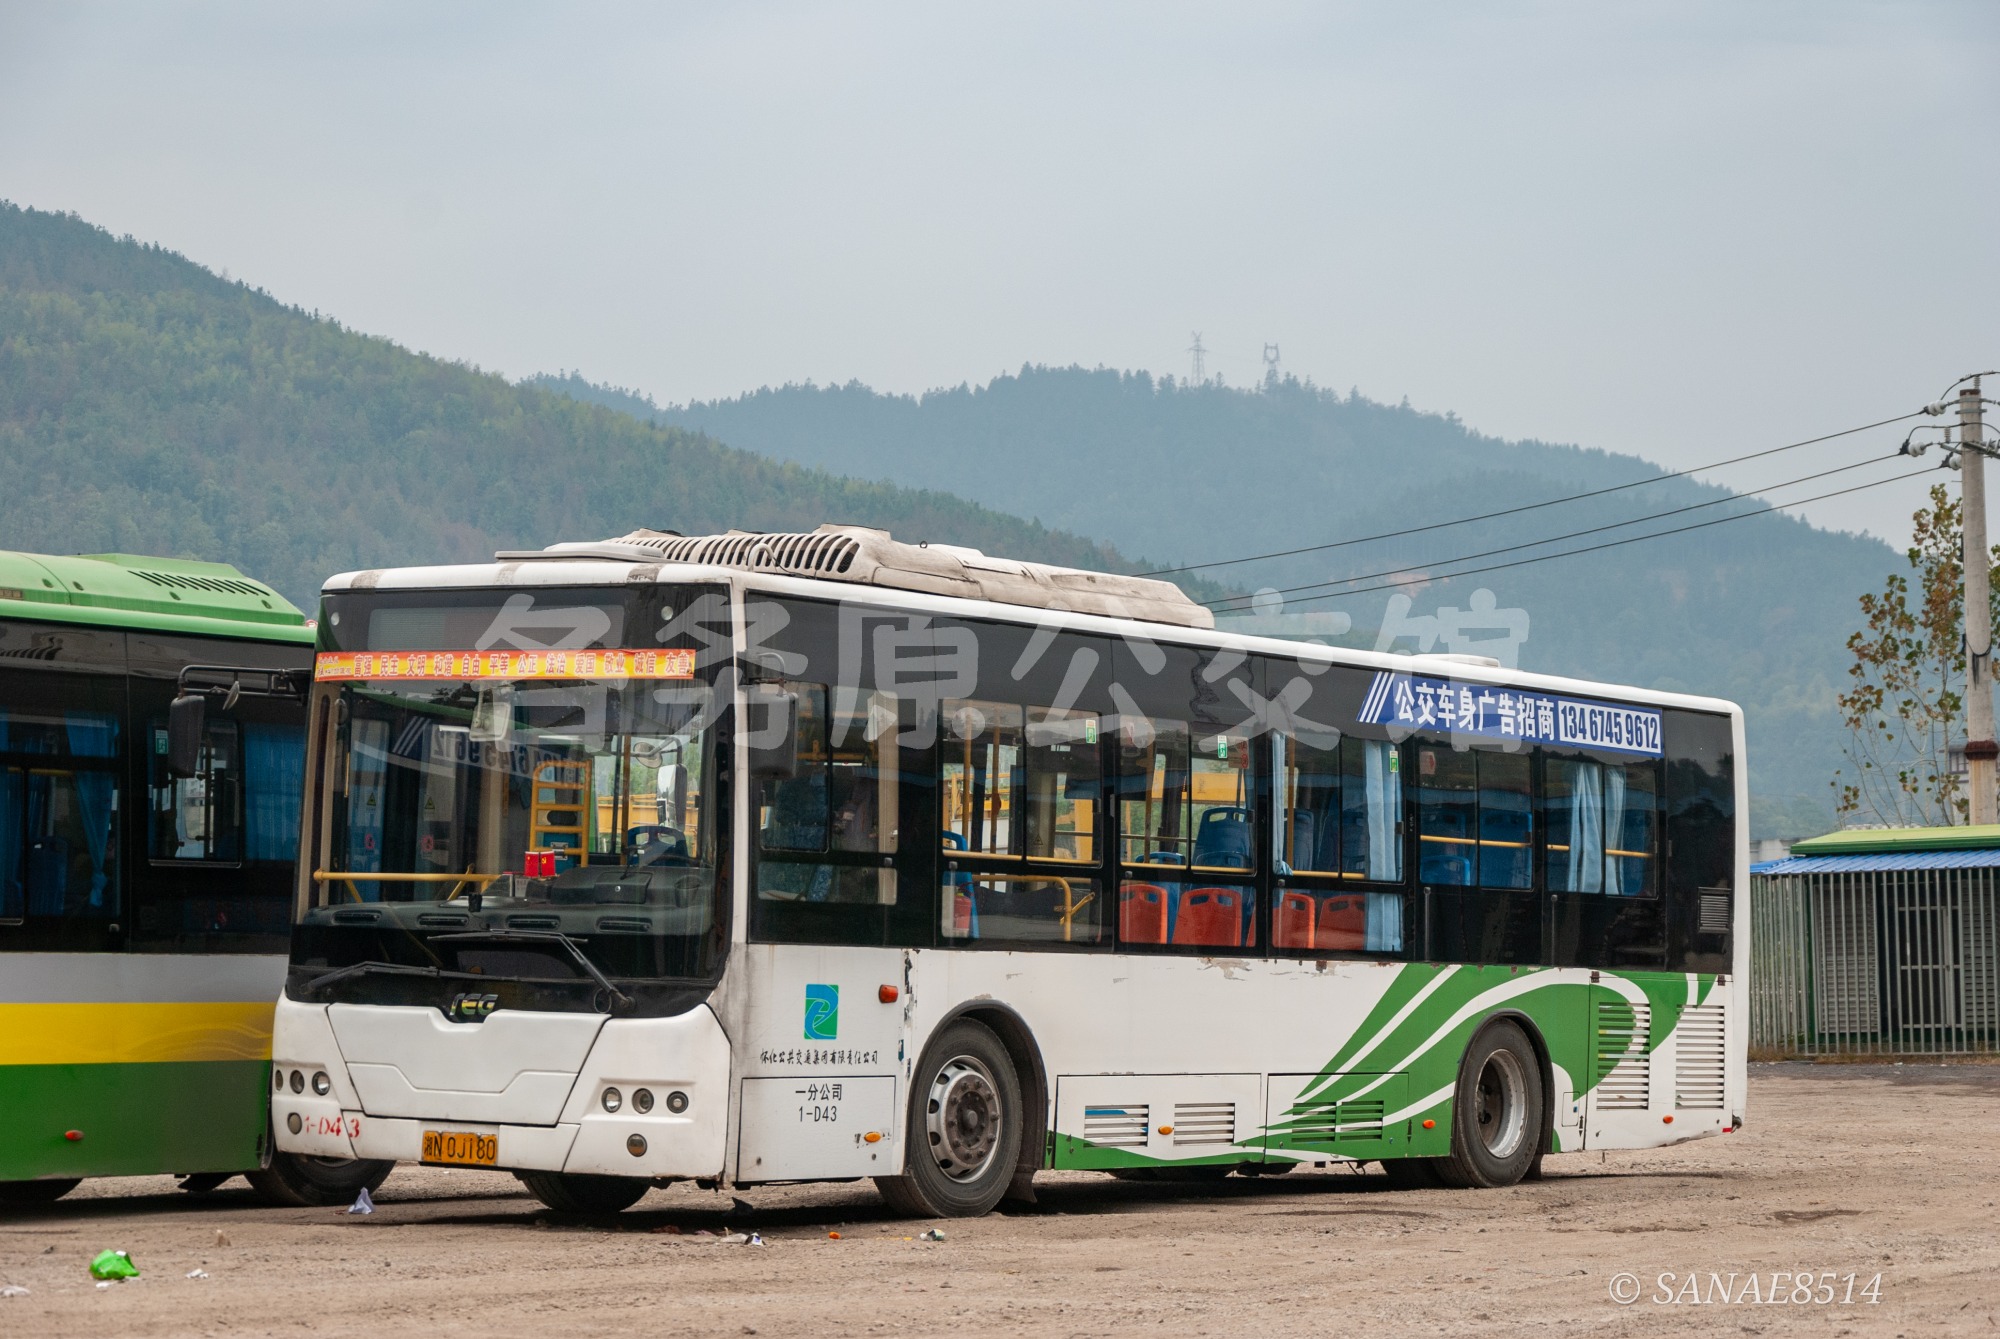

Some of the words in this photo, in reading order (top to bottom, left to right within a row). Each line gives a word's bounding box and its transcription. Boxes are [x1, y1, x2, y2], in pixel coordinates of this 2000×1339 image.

[354, 654, 372, 677] 富强
[380, 654, 399, 677] 民主
[406, 654, 426, 677] 文明
[434, 653, 454, 677] 和谐
[461, 653, 482, 676] 自由
[489, 653, 510, 676] 平等
[518, 653, 538, 675] 公正
[546, 652, 566, 675] 法治
[575, 652, 596, 675] 爱国
[604, 652, 625, 675] 敬业
[634, 652, 656, 675] 诚信
[665, 651, 690, 676] 友善
[1395, 680, 1555, 741] 公交车身广告招商
[1560, 705, 1587, 739] 134
[1588, 708, 1624, 744] 6745
[1626, 713, 1659, 749] 9612
[795, 1083, 842, 1101] 一分公司
[799, 1105, 837, 1122] 1-D43
[304, 1116, 360, 1138] 1-D43
